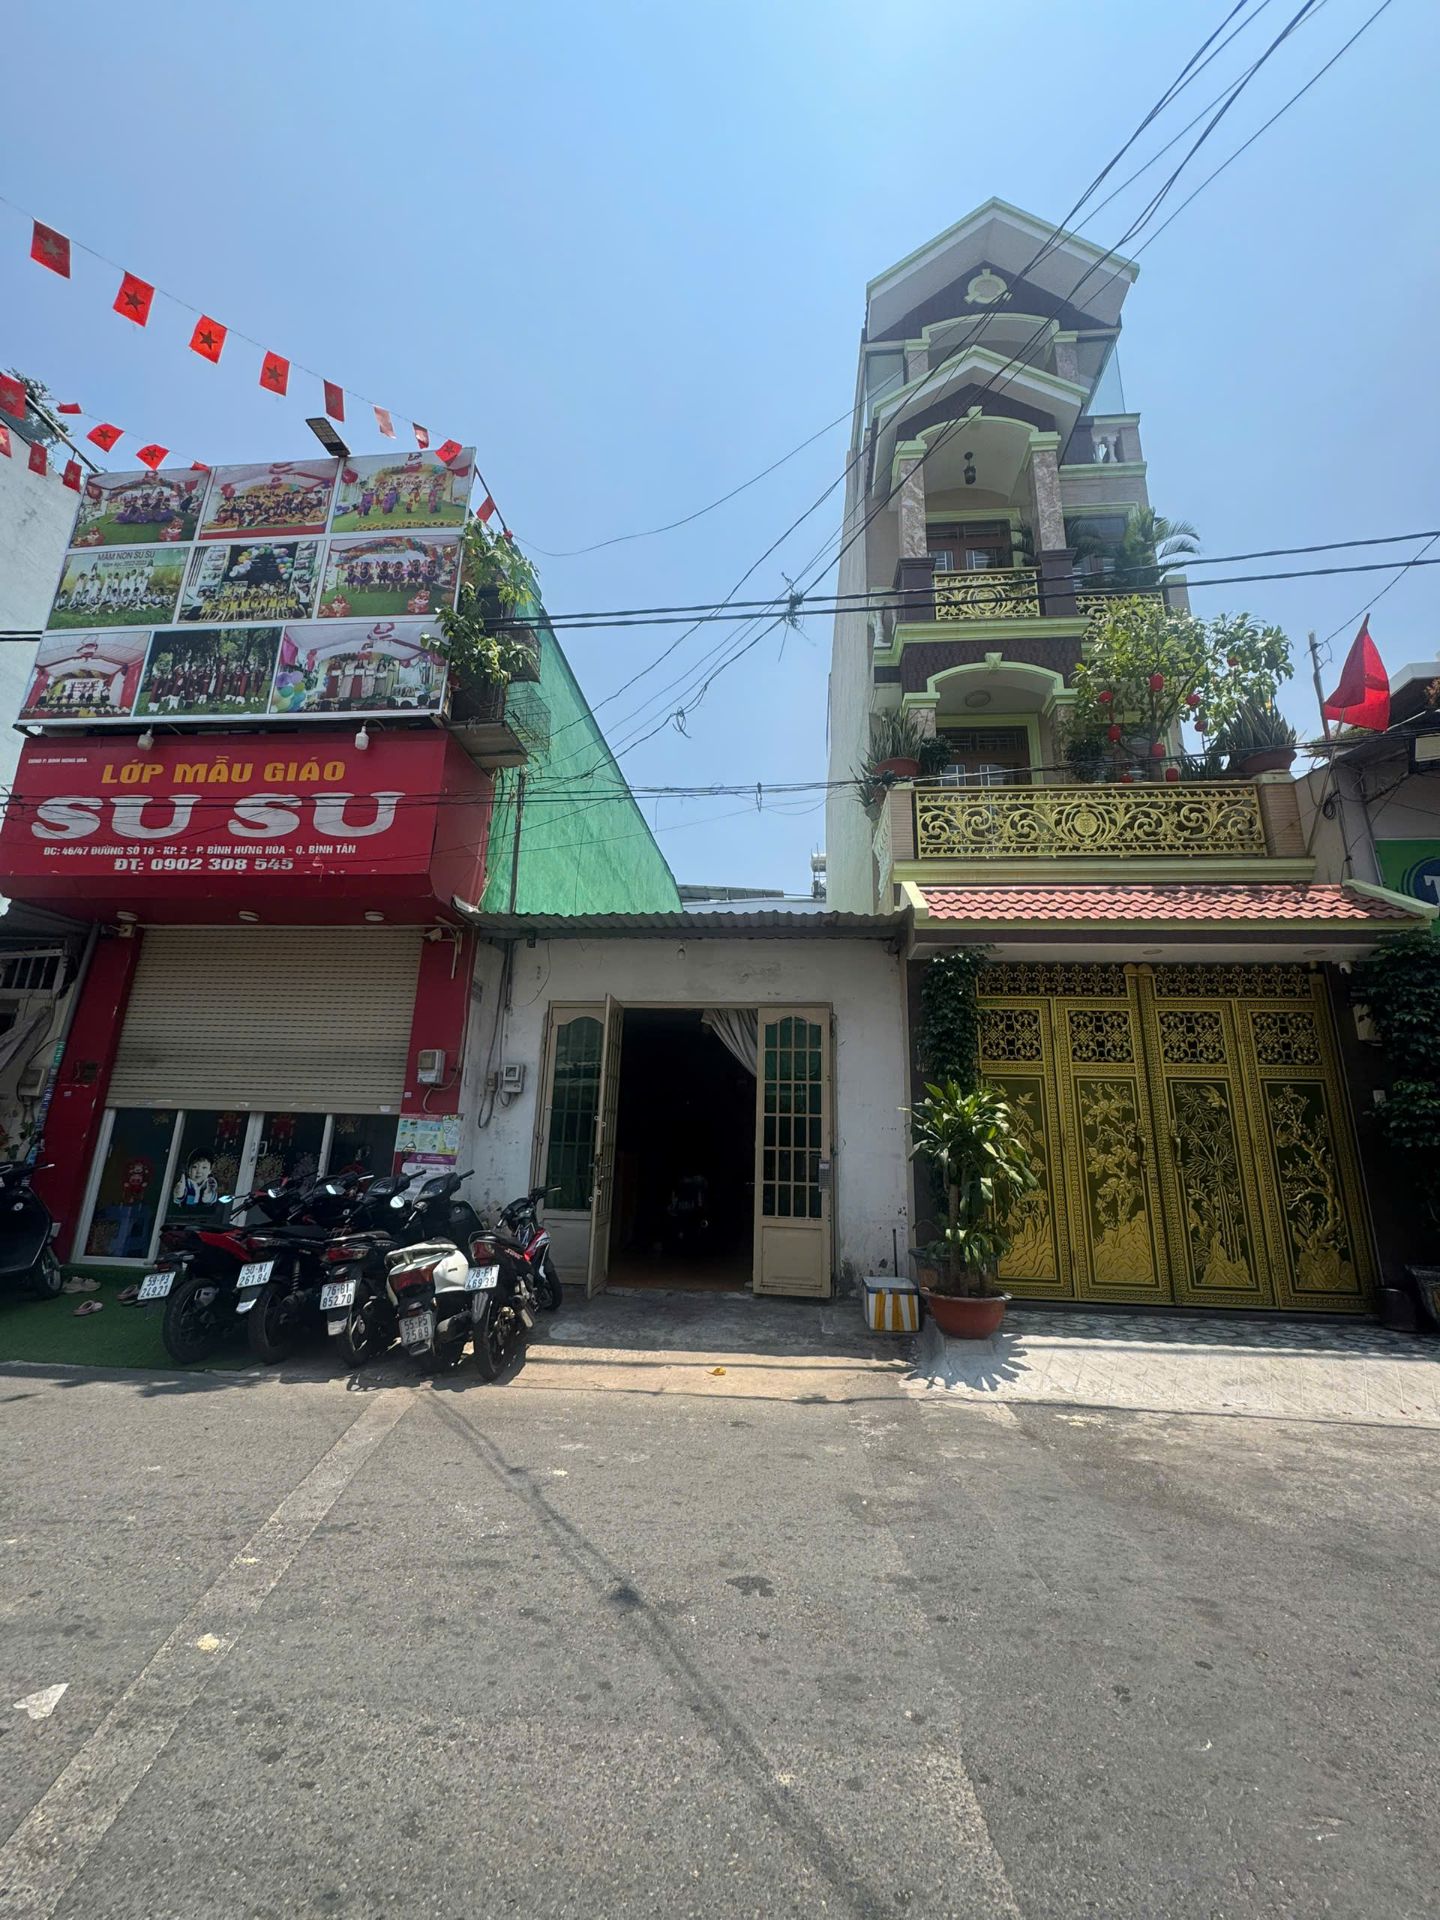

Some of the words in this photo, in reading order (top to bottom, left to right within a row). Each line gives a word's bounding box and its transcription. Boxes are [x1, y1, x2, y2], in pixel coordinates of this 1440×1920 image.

[101, 758, 164, 784] LỚP
[173, 755, 254, 784] MẪU
[263, 757, 345, 782] GIÁO
[31, 794, 202, 840] SU
[227, 791, 406, 838] SU
[43, 846, 61, 856] ĐC:
[62, 846, 89, 855] 46/47
[90, 844, 125, 855] ĐƯỜNG
[126, 843, 140, 855] SỐ
[143, 846, 155, 855] 18
[163, 846, 178, 855] KP.
[180, 846, 188, 855] 2
[196, 846, 204, 854] P.
[207, 844, 232, 855] BÌNH
[234, 844, 264, 854] HƯNG
[265, 844, 286, 854] HÒA
[296, 845, 306, 856] Q.
[308, 842, 334, 854] BÌNH
[336, 843, 357, 854] TÂN
[114, 858, 145, 871] ĐT:
[150, 858, 203, 871] 0902
[208, 858, 248, 871] 308
[254, 857, 294, 870] 545
[471, 1267, 493, 1278] 78-F1
[240, 1274, 268, 1286] 261.84
[466, 1276, 495, 1290] 46939
[140, 1284, 168, 1298] 249.21
[326, 1283, 350, 1295] 76-B1
[322, 1293, 352, 1308] 852.70
[404, 1316, 428, 1331] 55-P5
[406, 1327, 430, 1344] 2589
